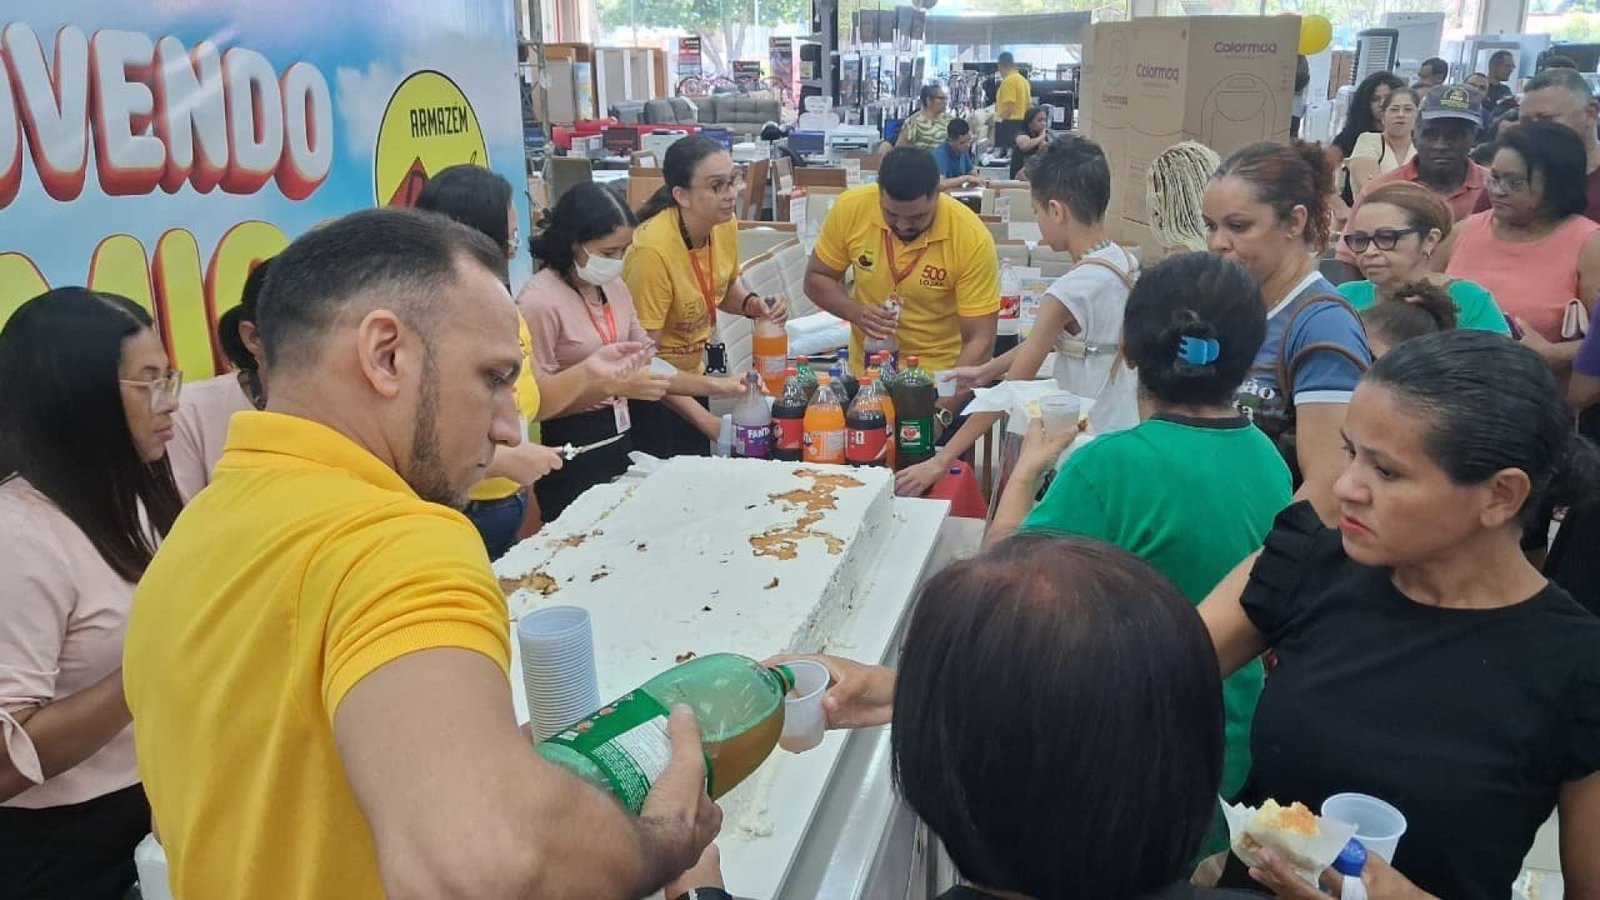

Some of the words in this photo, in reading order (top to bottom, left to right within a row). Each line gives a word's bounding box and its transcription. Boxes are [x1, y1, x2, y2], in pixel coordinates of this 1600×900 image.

[1213, 41, 1277, 54] Colormaq
[1136, 62, 1180, 84] Colormaq
[410, 101, 468, 138] ARMAZÉM
[921, 264, 948, 282] 500
[747, 427, 770, 439] FANT
